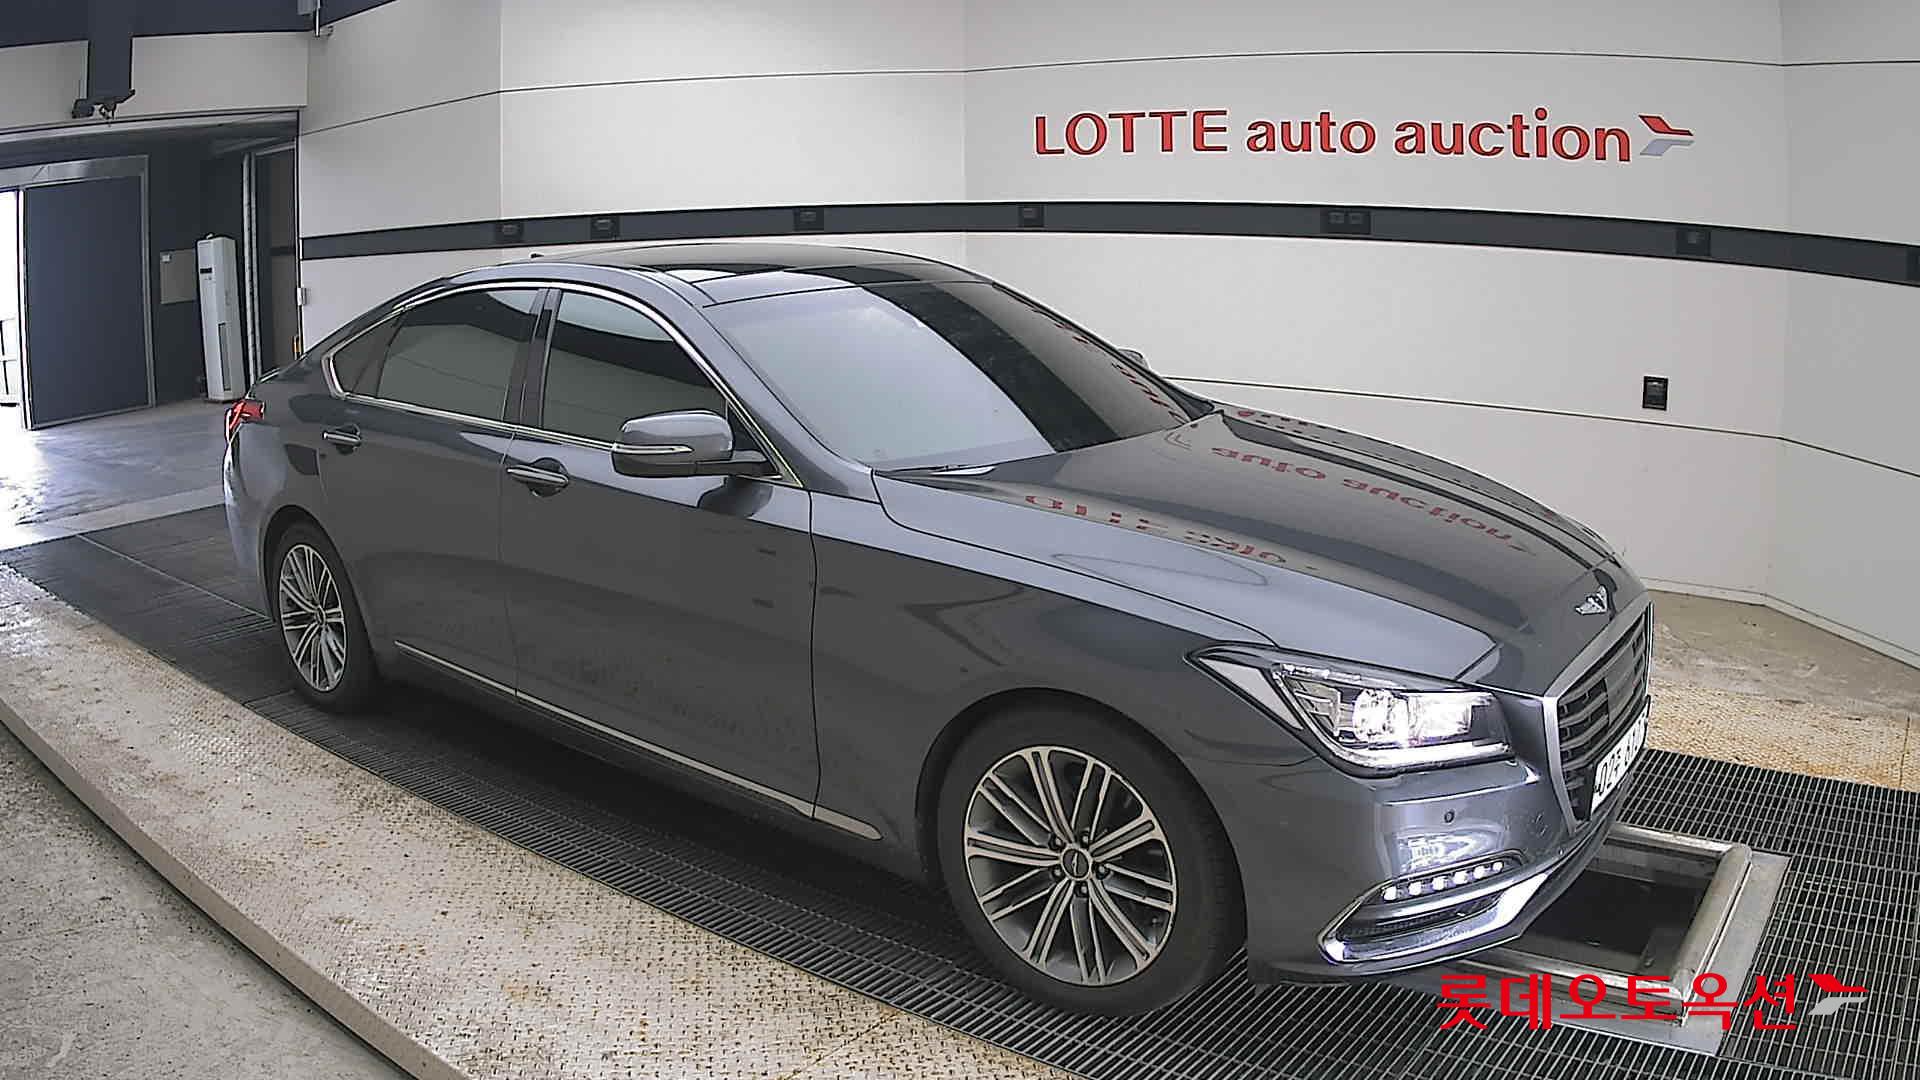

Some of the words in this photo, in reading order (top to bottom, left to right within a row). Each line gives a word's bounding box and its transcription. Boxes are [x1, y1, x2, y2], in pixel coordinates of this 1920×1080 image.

[1035, 110, 1227, 155] LOTTE
[1246, 111, 1376, 154] auto
[1394, 108, 1631, 162] auction
